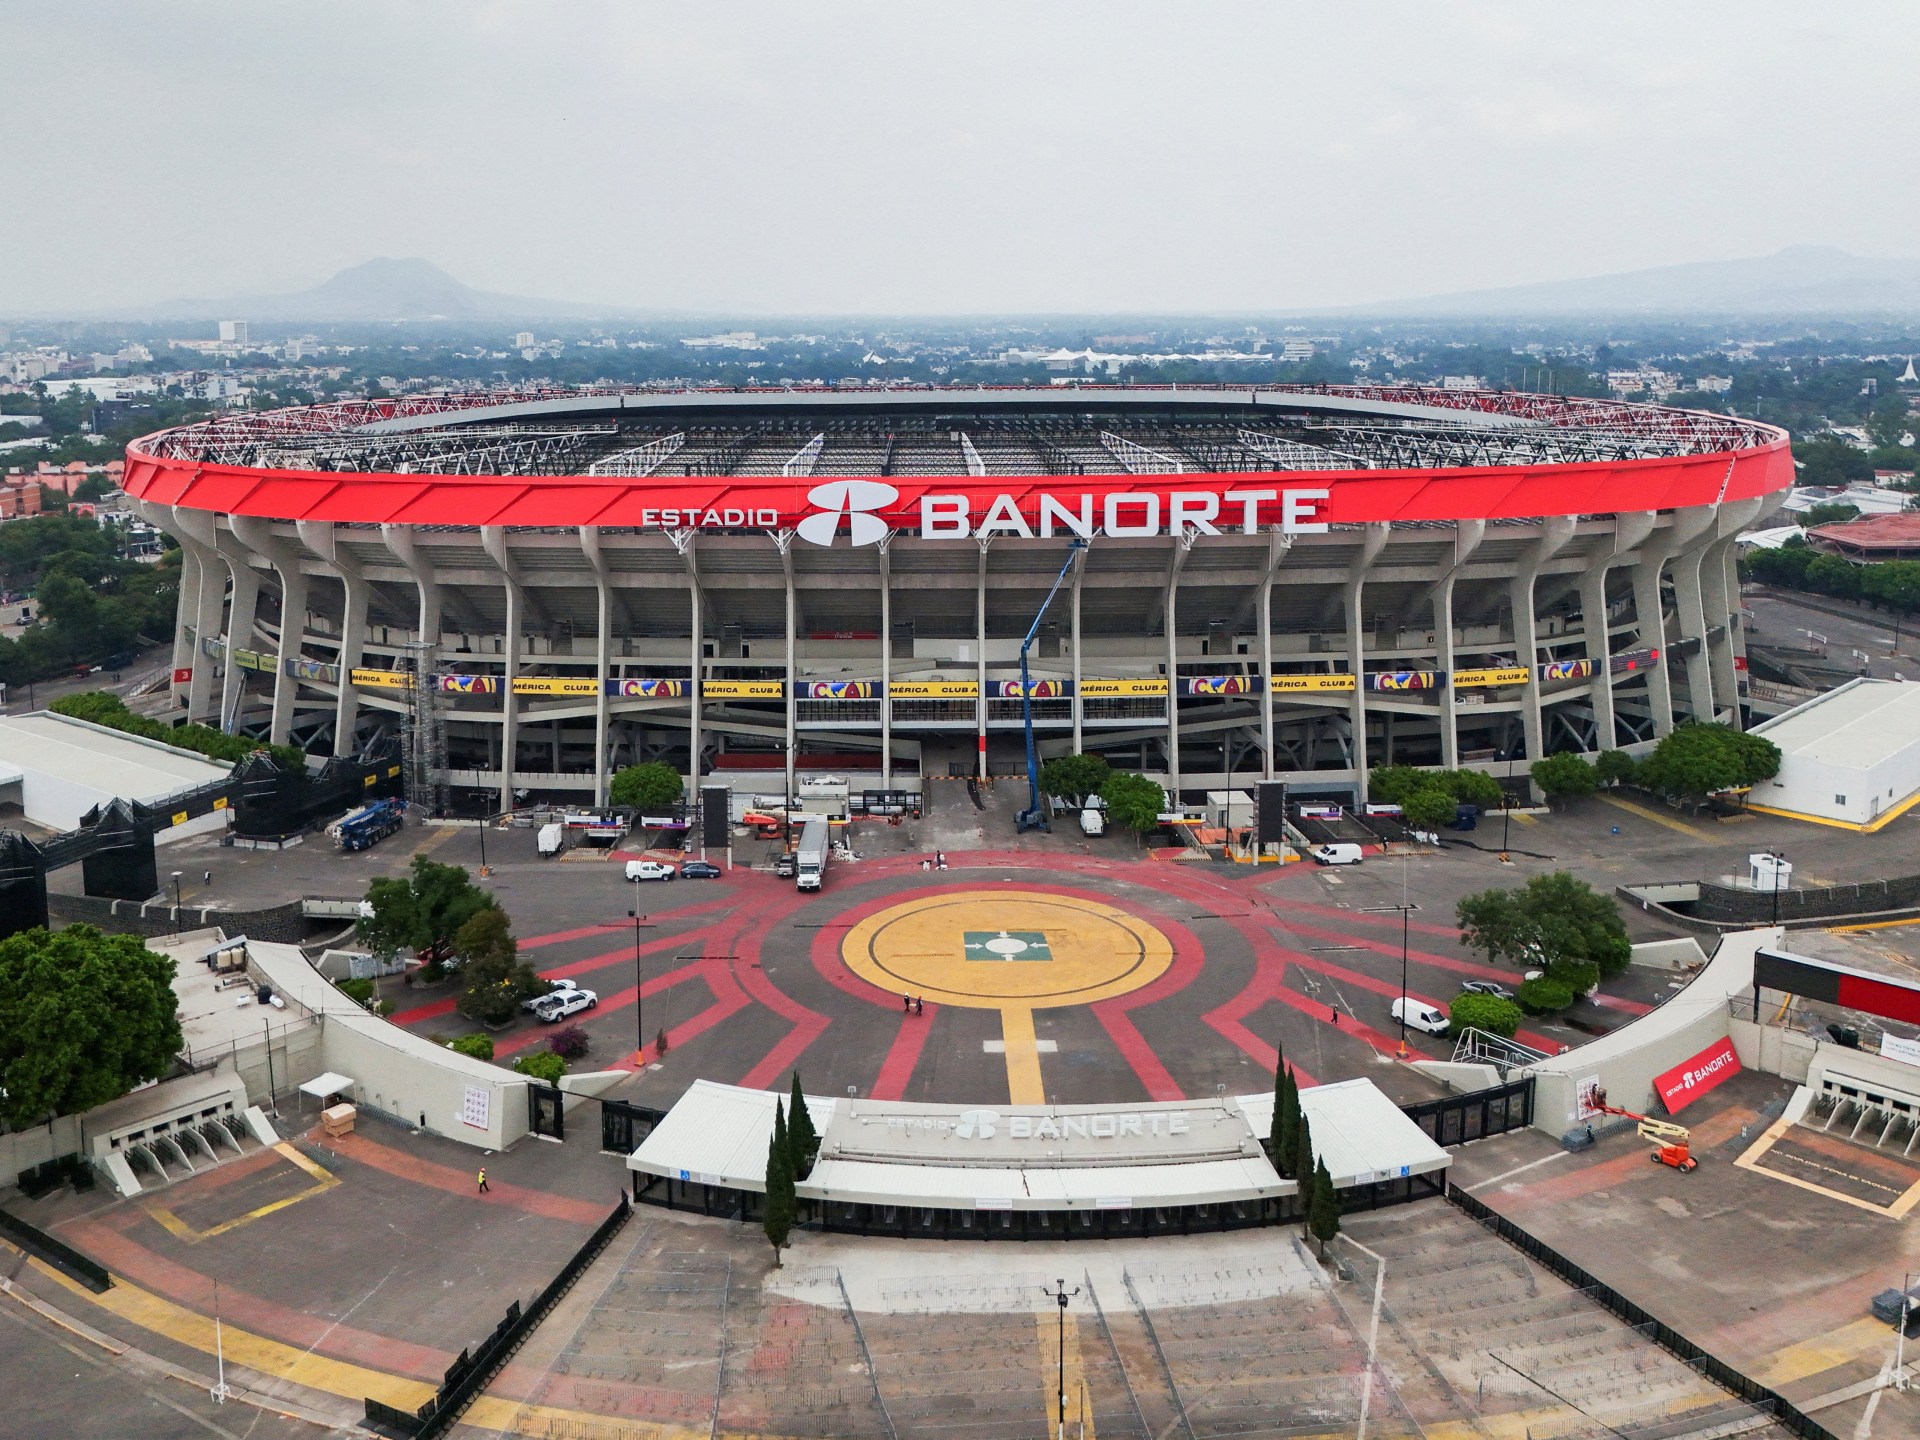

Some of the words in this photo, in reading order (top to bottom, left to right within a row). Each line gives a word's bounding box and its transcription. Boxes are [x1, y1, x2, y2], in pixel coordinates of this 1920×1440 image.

[642, 508, 778, 526] ESTADIO
[921, 489, 1330, 539] BANORTE
[182, 672, 188, 680] 3
[352, 674, 381, 682] MÉRICA
[512, 682, 552, 690] MÉRICA
[1080, 682, 1120, 692] MÉRICA
[1271, 678, 1308, 688] MÉRICA
[703, 684, 738, 693] MÉRICA
[890, 684, 928, 693] MÉRICA
[1666, 1083, 1684, 1097] ESTADIO
[1694, 1050, 1734, 1082] BANORTE
[888, 1118, 948, 1130] ESTADIO
[1010, 1112, 1190, 1138] BANORTE
